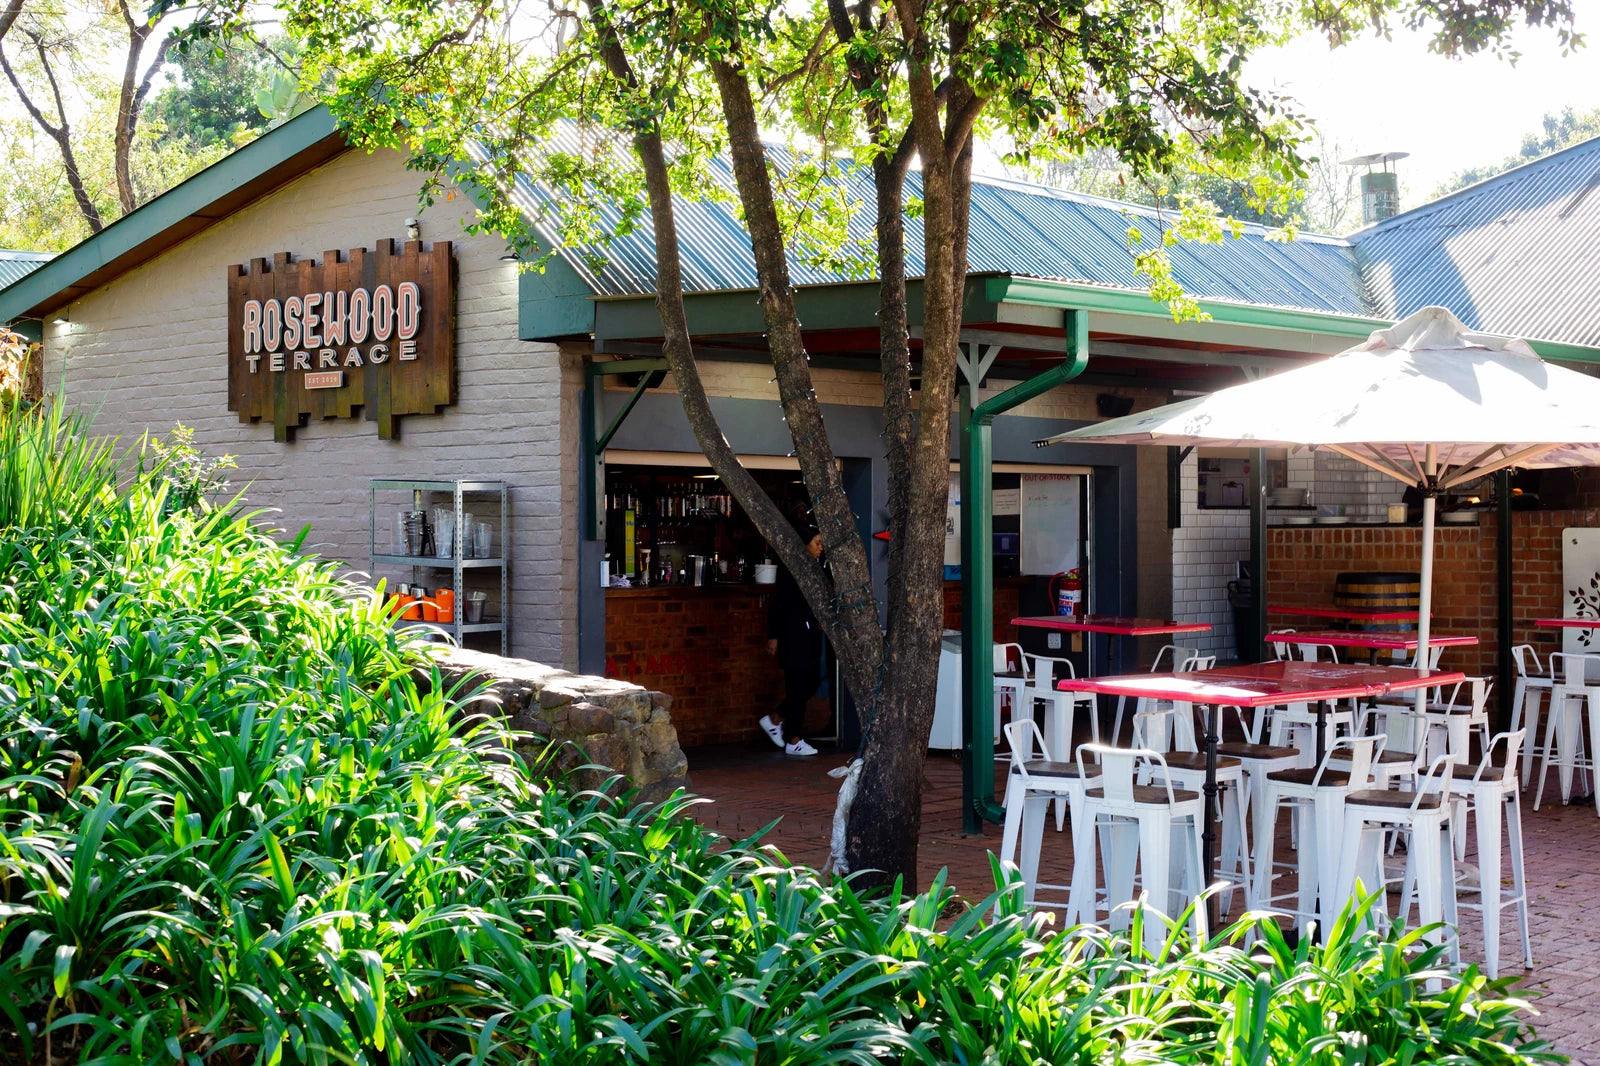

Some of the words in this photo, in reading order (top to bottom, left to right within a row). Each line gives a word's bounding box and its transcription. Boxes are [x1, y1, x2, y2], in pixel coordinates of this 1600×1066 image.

[243, 282, 421, 353] ROSEWOOD
[245, 340, 417, 373] TERRACE
[1024, 474, 1037, 482] OUT
[1040, 474, 1048, 482] OF
[1048, 473, 1071, 481] STOCK
